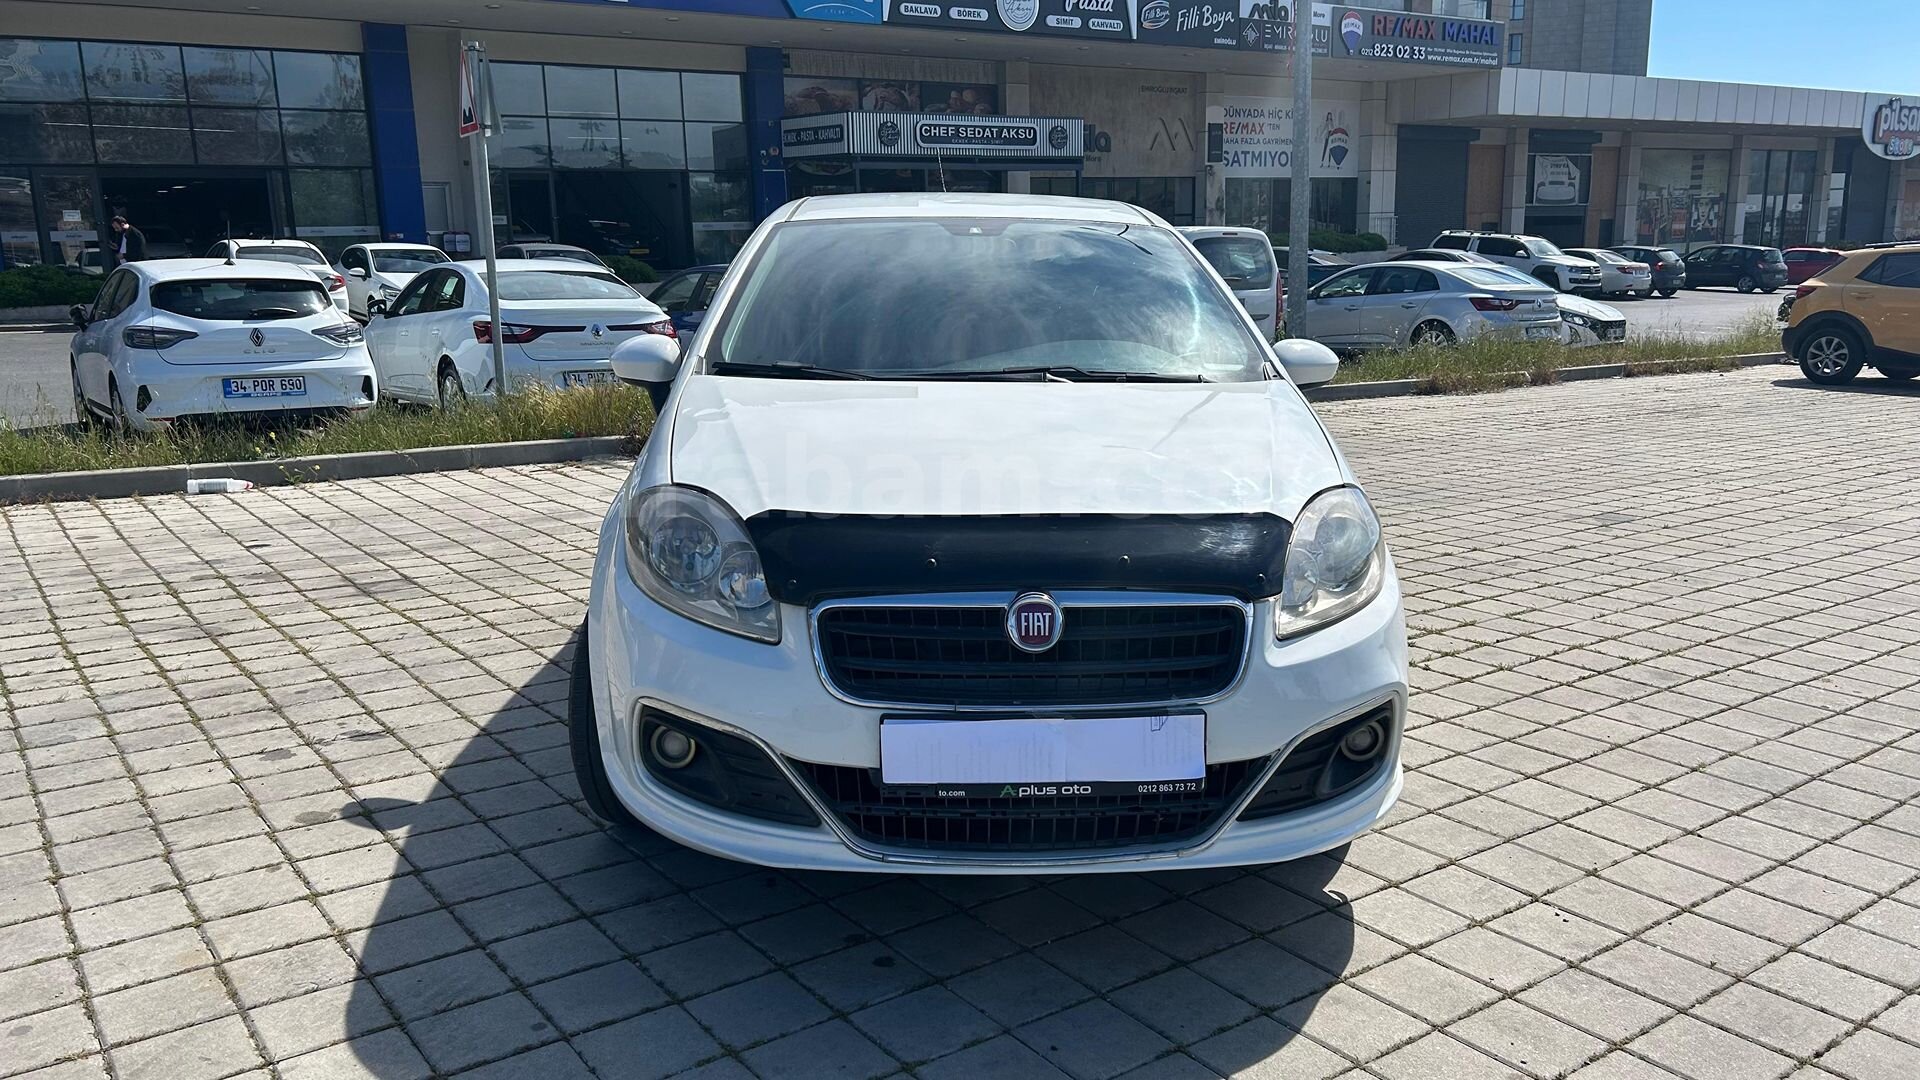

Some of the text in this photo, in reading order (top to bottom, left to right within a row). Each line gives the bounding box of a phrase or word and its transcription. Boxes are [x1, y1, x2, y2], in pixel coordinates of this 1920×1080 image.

[904, 5, 939, 16] BAKLAVA
[957, 9, 982, 20] BÖREK
[1091, 20, 1121, 30] KAHVALTI
[1176, 5, 1235, 32] Filli Boya
[1372, 15, 1498, 46] RE/MAX MAHAL
[1361, 47, 1373, 56] 0212
[1374, 44, 1393, 57] 823
[1396, 46, 1409, 59] 02
[1412, 47, 1426, 59] 33
[1268, 108, 1283, 121] HİÇ
[922, 126, 1034, 139] CHEF SEDAT AKSU
[232, 378, 303, 393] 34 POR 690
[1020, 612, 1052, 637] FIAT
[938, 789, 966, 797] to.com
[1061, 784, 1092, 795] oto
[1138, 782, 1197, 793] 0212 863 73 72
